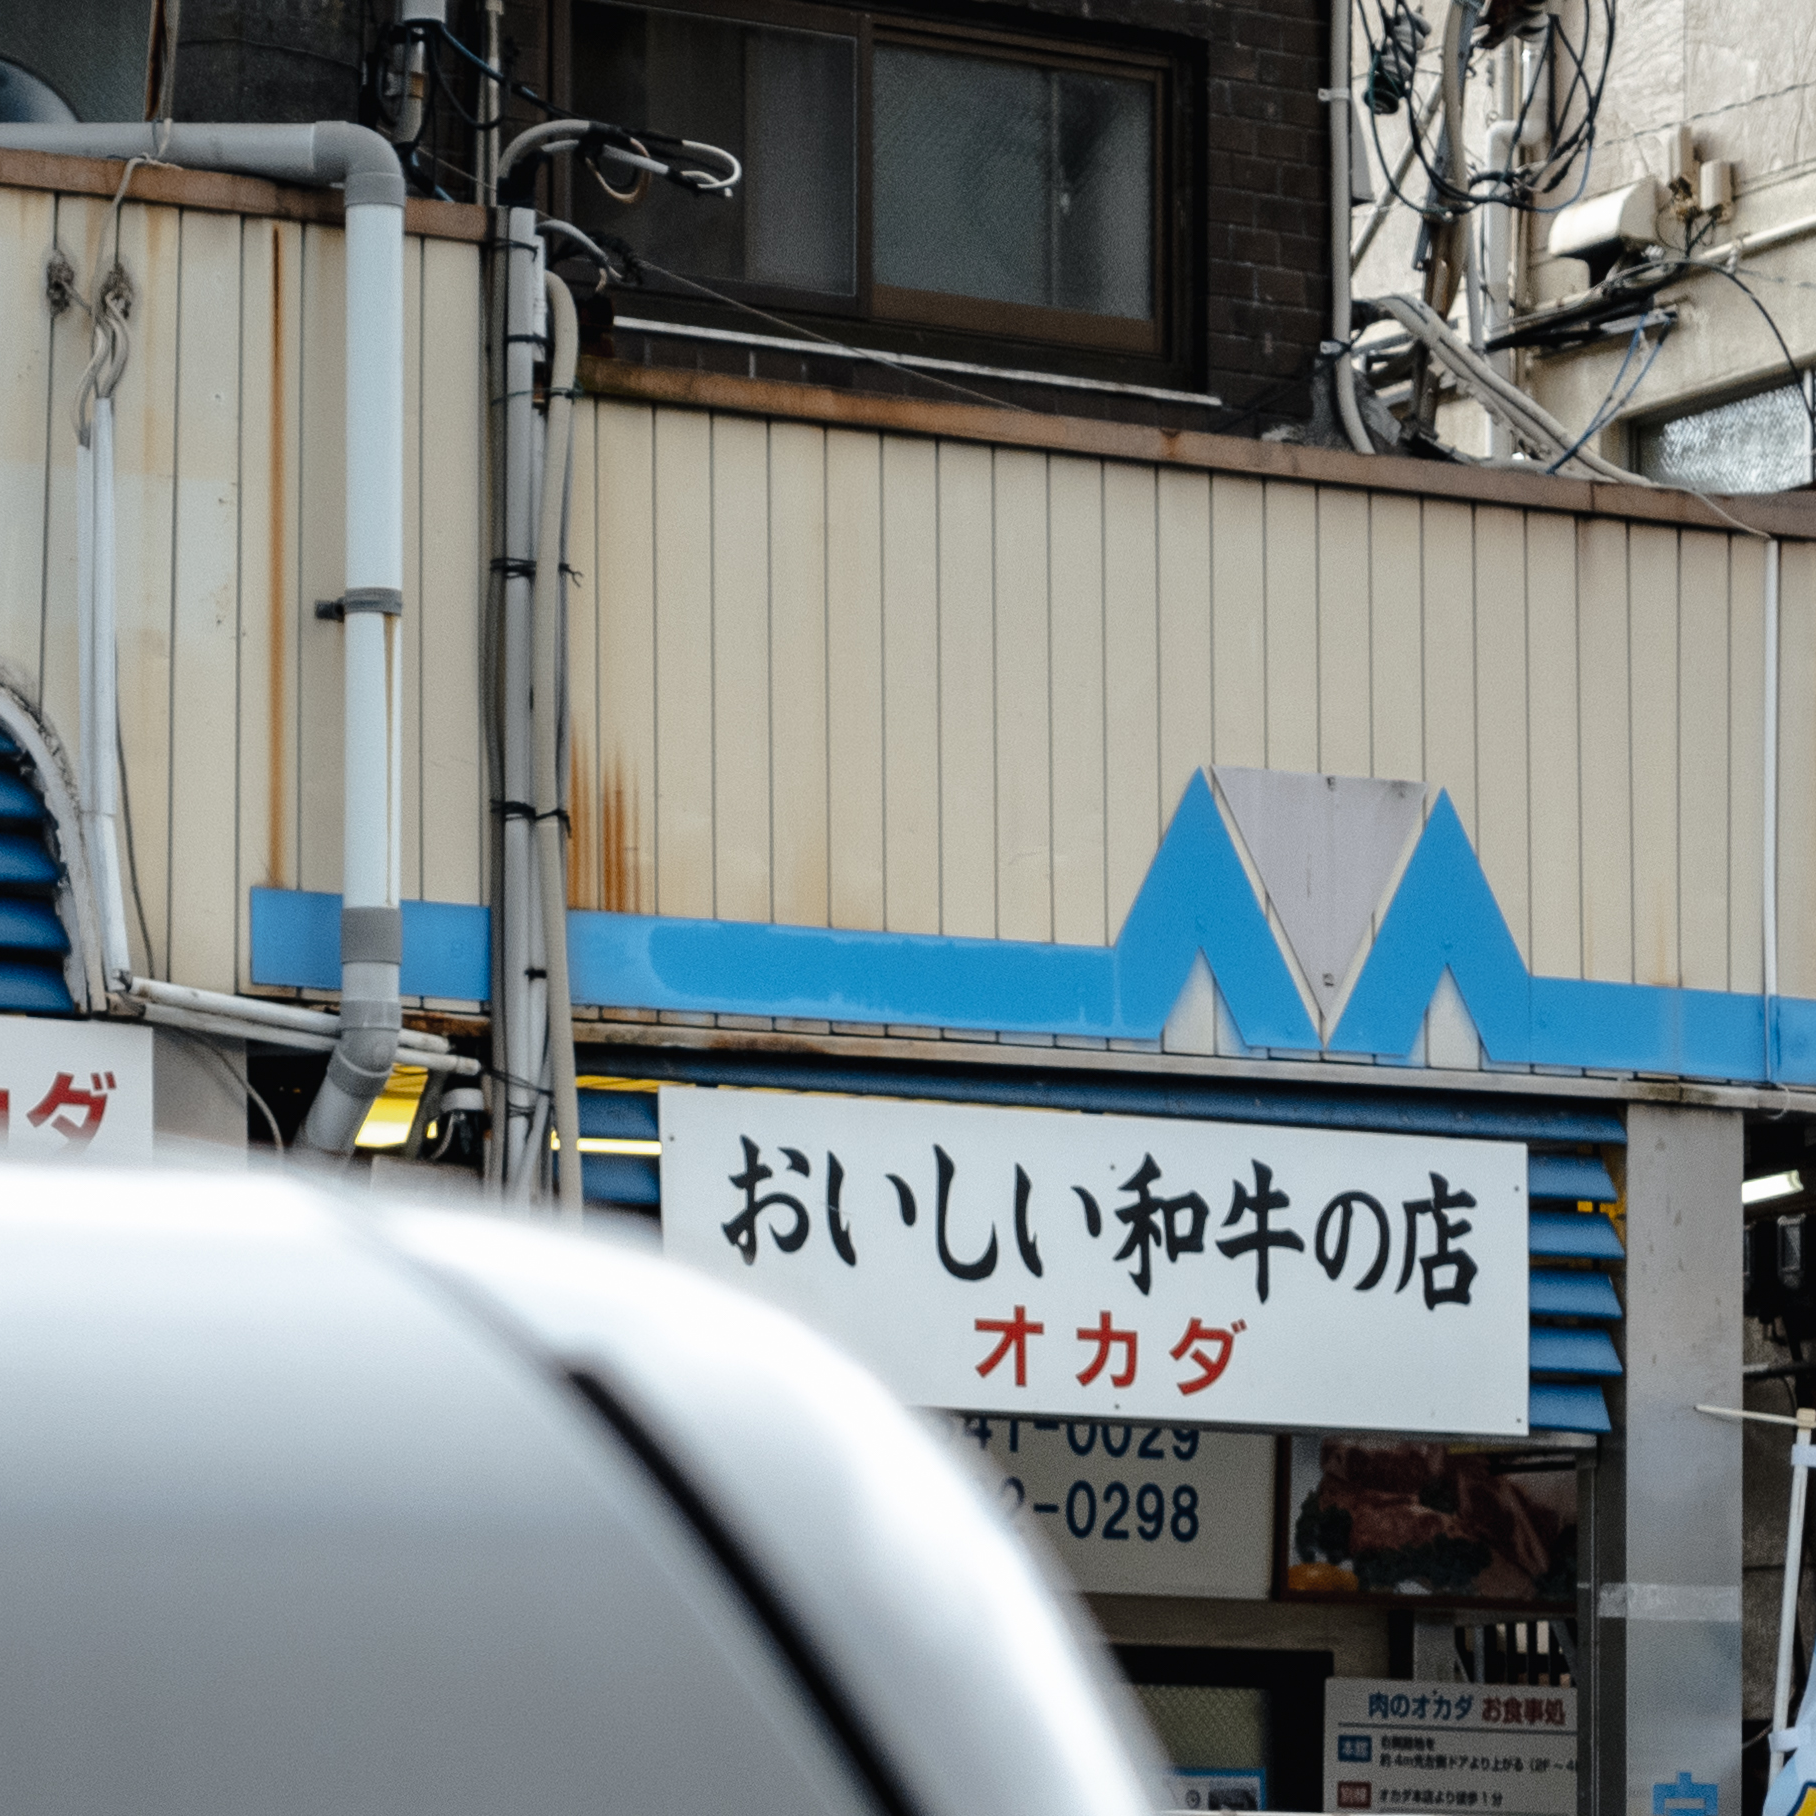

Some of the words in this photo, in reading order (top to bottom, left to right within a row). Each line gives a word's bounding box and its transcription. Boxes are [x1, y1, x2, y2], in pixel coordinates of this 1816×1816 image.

[720, 1133, 1479, 1312] おいしい和牛の店
[973, 1303, 1247, 1396] オカダ
[1368, 1691, 1475, 1721] 肉のオカダ
[1481, 1696, 1567, 1726] お食事処
